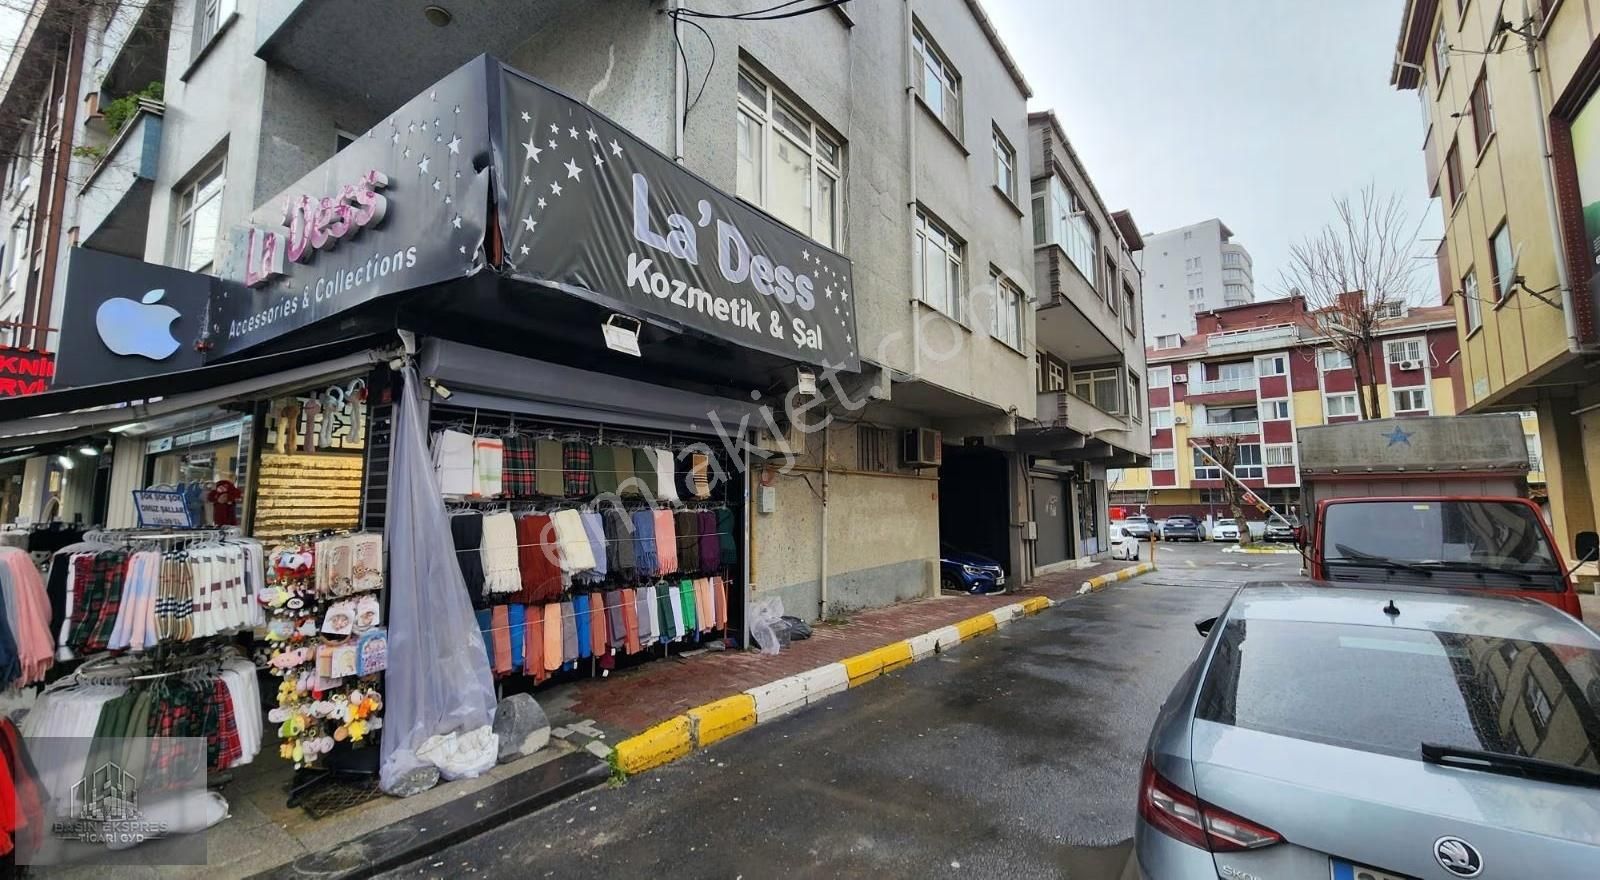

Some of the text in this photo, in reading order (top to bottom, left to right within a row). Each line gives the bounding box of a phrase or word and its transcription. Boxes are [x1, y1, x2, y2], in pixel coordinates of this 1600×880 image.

[228, 246, 417, 339] Accessories & Collections
[626, 252, 823, 351] Kozmetik & Şal
